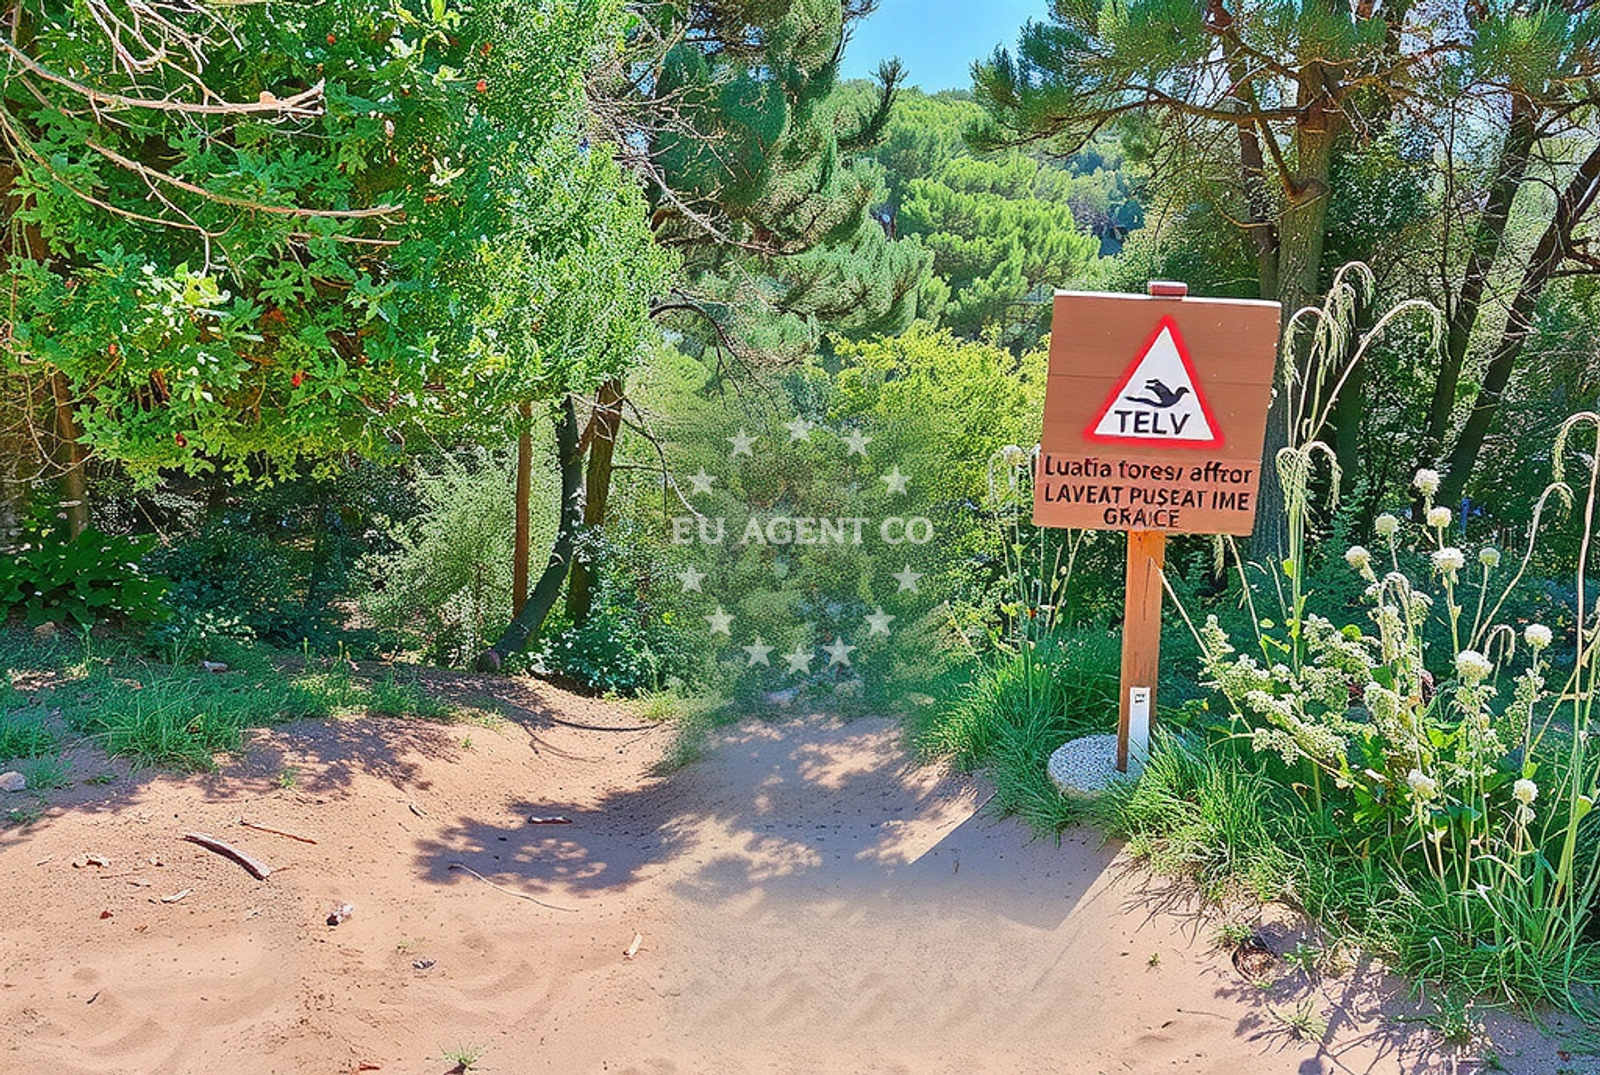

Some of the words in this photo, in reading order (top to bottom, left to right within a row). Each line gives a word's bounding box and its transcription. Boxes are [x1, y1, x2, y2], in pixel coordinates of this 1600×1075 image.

[1114, 409, 1191, 435] TELV
[1045, 483, 1123, 504] LAVEAT
[1212, 490, 1250, 511] IME
